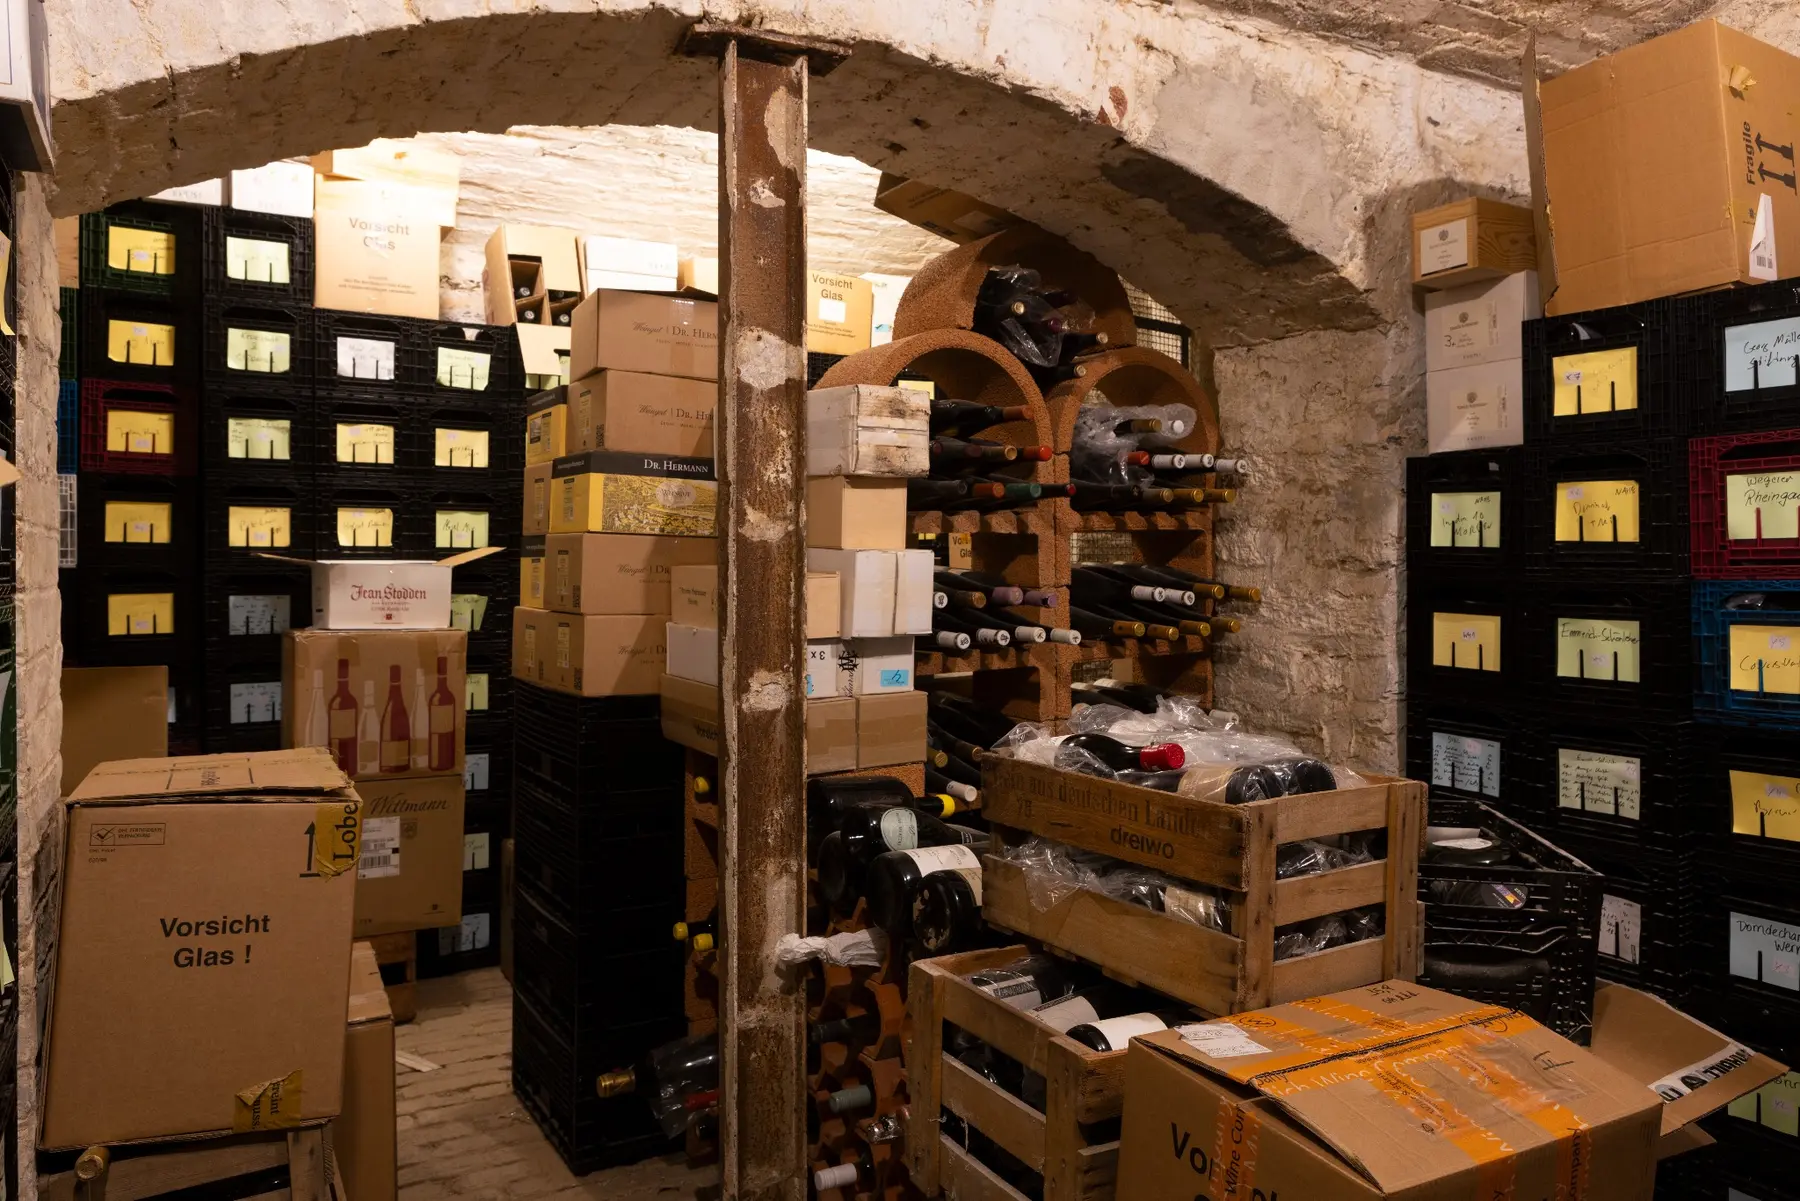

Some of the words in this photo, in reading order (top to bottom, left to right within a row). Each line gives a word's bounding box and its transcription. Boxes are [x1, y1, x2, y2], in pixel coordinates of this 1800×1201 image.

[1742, 121, 1757, 186] Fragile
[812, 273, 853, 290] Vorsicht
[820, 288, 844, 301] Glas
[644, 458, 661, 470] DR.
[663, 460, 709, 473] HERMANN
[351, 584, 382, 601] Jean
[383, 583, 427, 600] Stodden
[1029, 776, 1054, 799] aus
[369, 792, 450, 815] Wittmann
[160, 914, 271, 938] Vorsicht
[174, 945, 234, 968] Glas
[244, 944, 251, 964] !
[1224, 1149, 1242, 1195] Wine
